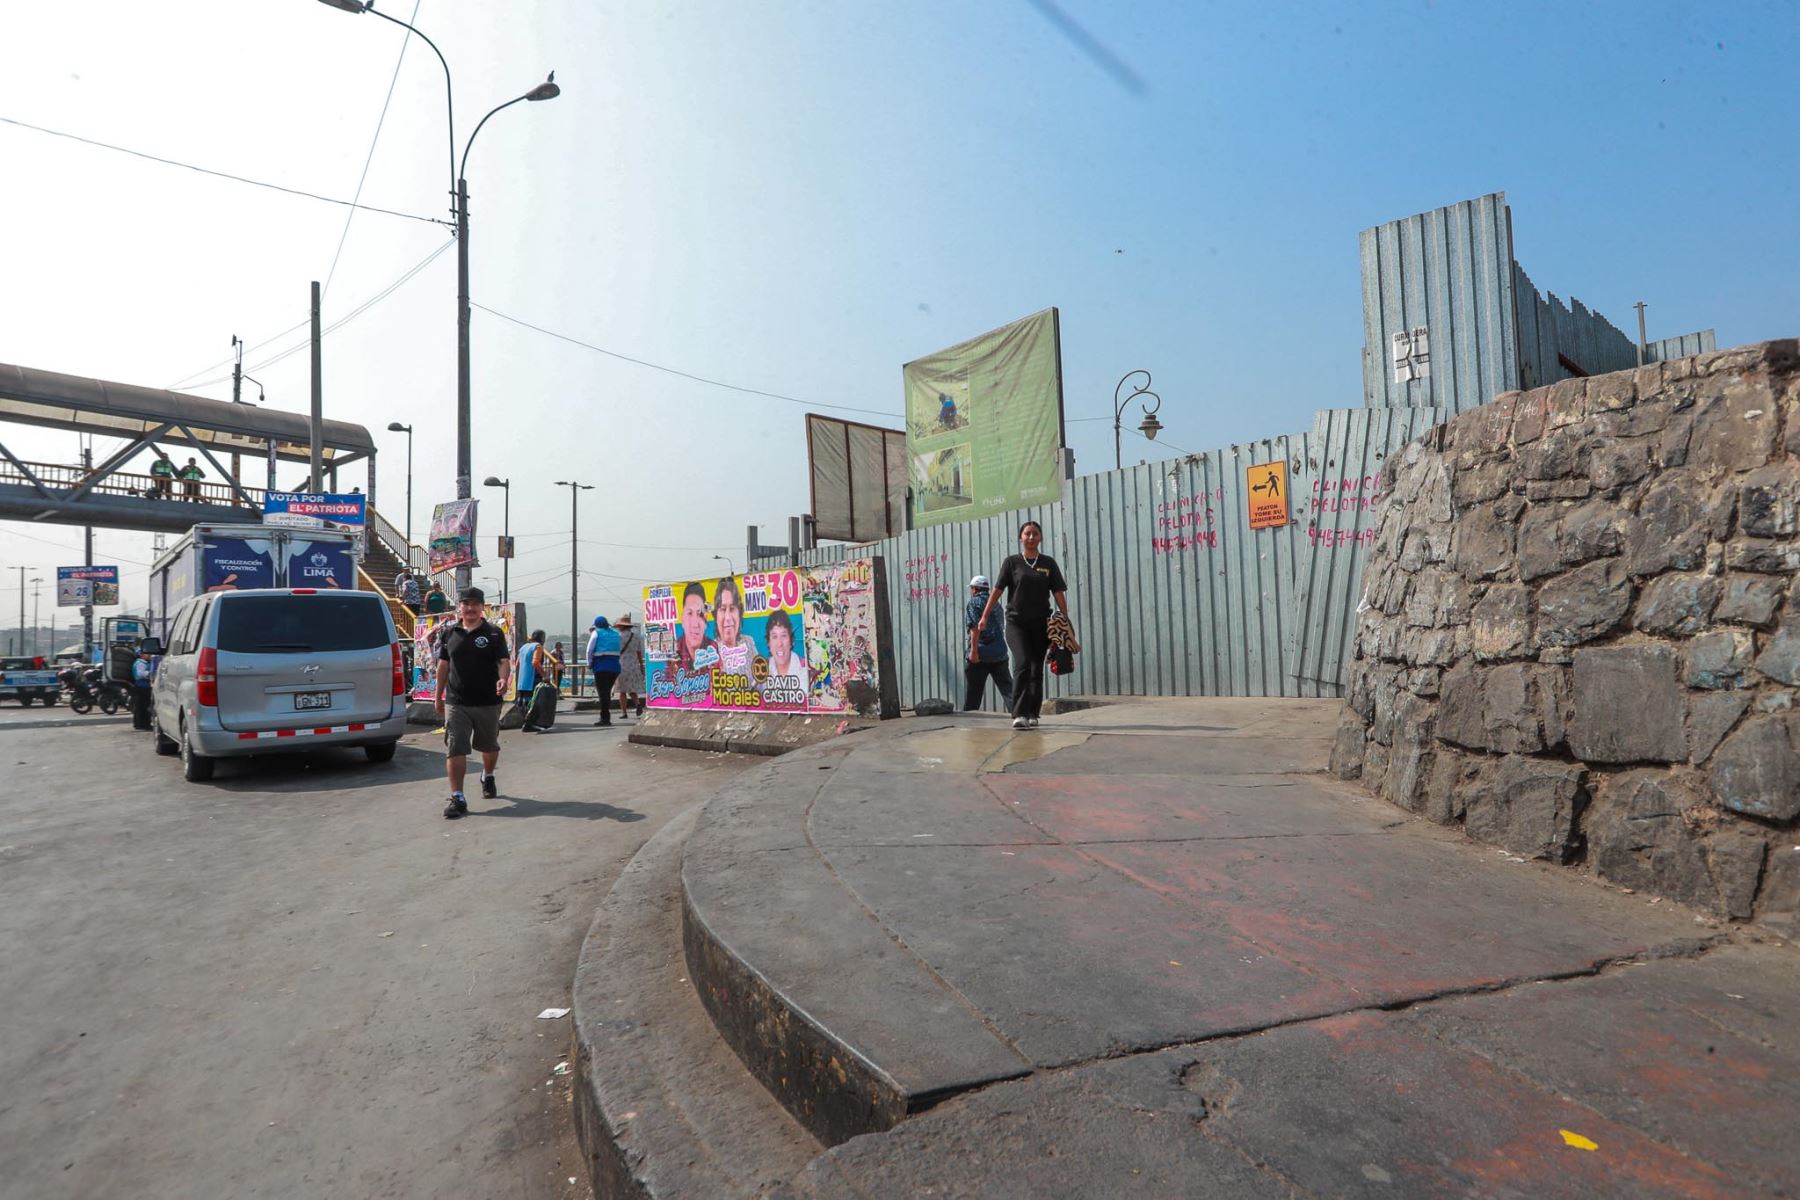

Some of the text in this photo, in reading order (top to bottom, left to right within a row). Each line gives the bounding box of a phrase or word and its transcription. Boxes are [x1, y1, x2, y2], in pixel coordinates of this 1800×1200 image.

[1394, 328, 1427, 342] CURADERA
[269, 493, 324, 503] VOTA POR
[289, 504, 358, 513] EL PATRIOTA
[1251, 515, 1285, 523] IZQUIERDA
[214, 558, 263, 566] FISCALIZACIÓN
[303, 569, 335, 577] LIMA
[743, 574, 766, 589] SAB
[768, 571, 799, 609] 30
[745, 591, 767, 612] MAYO
[645, 598, 677, 622] SANTA
[711, 667, 748, 689] Edson
[767, 676, 800, 689] DAVID
[712, 688, 760, 706] Morales
[763, 689, 805, 704] CASTRO
